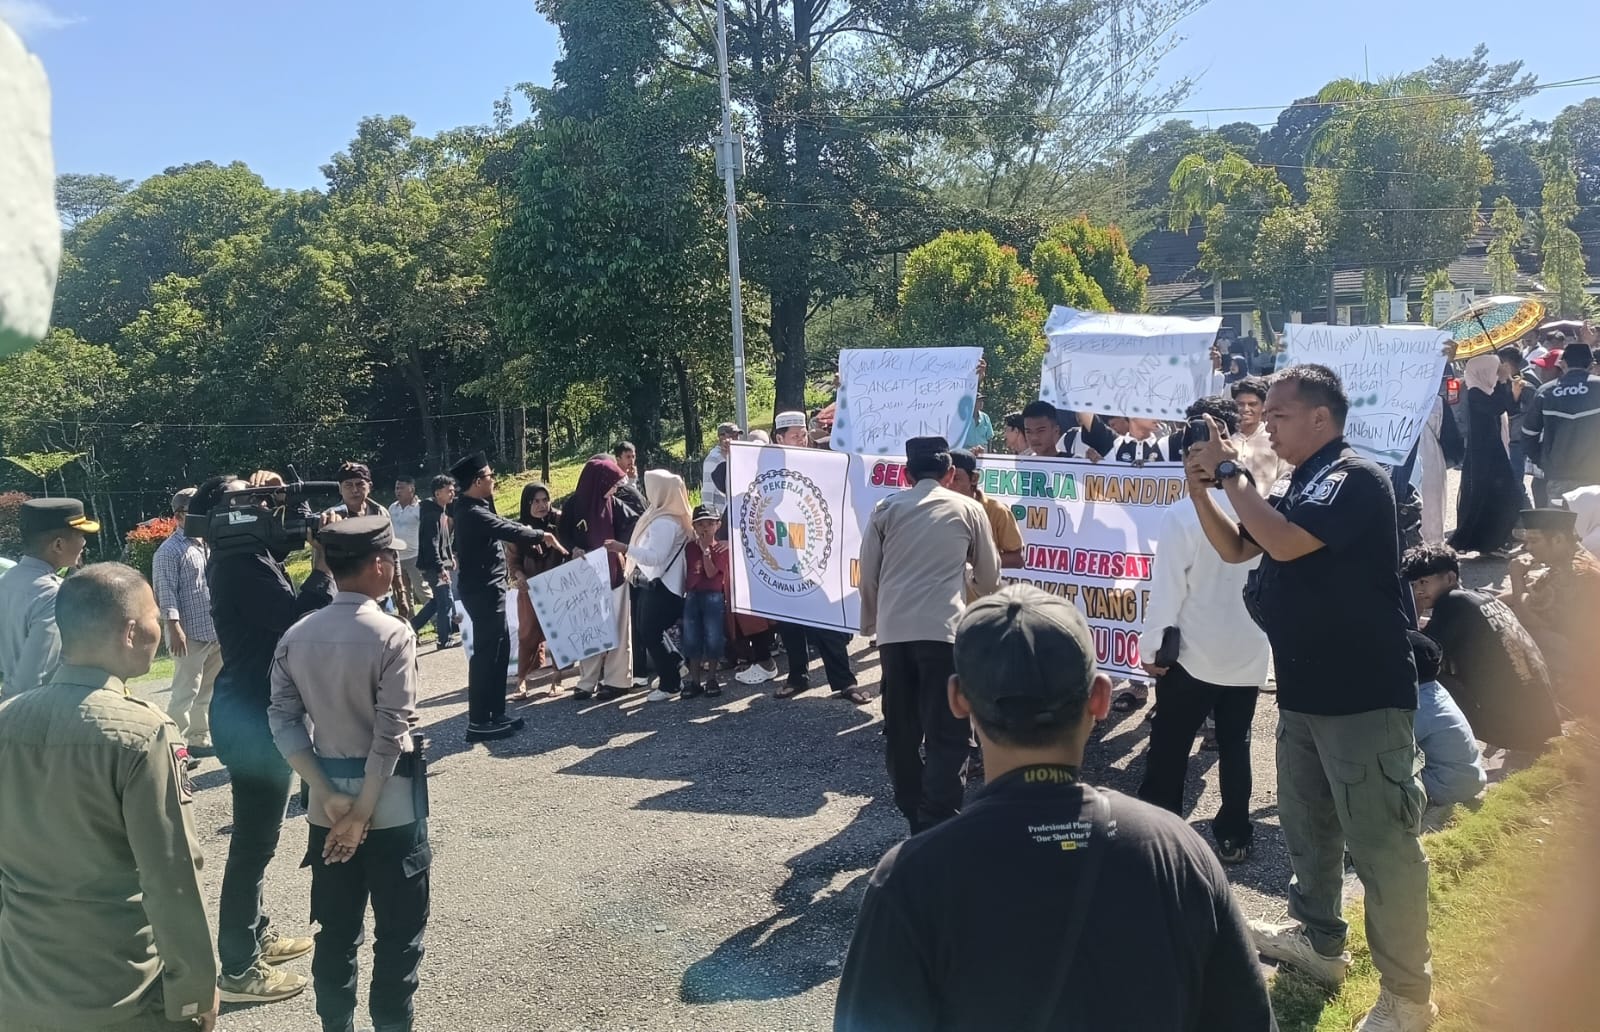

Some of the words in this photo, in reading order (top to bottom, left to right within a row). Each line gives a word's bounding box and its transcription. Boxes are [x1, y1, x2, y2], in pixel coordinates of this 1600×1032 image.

[1291, 327, 1332, 352] KAMI
[1552, 382, 1590, 398] Grab
[1345, 420, 1383, 439] ANGUN
[748, 489, 763, 533] SERIKAT
[762, 480, 804, 498] PEKERJA
[802, 494, 824, 542] MANDIRI
[764, 519, 806, 550] SPM
[1026, 545, 1070, 572] JAYA
[1074, 549, 1154, 580] BERSAT
[758, 569, 797, 593] PELAWAN
[797, 578, 816, 593] JAYA
[1082, 585, 1137, 623] YANG
[1112, 631, 1143, 669] DO
